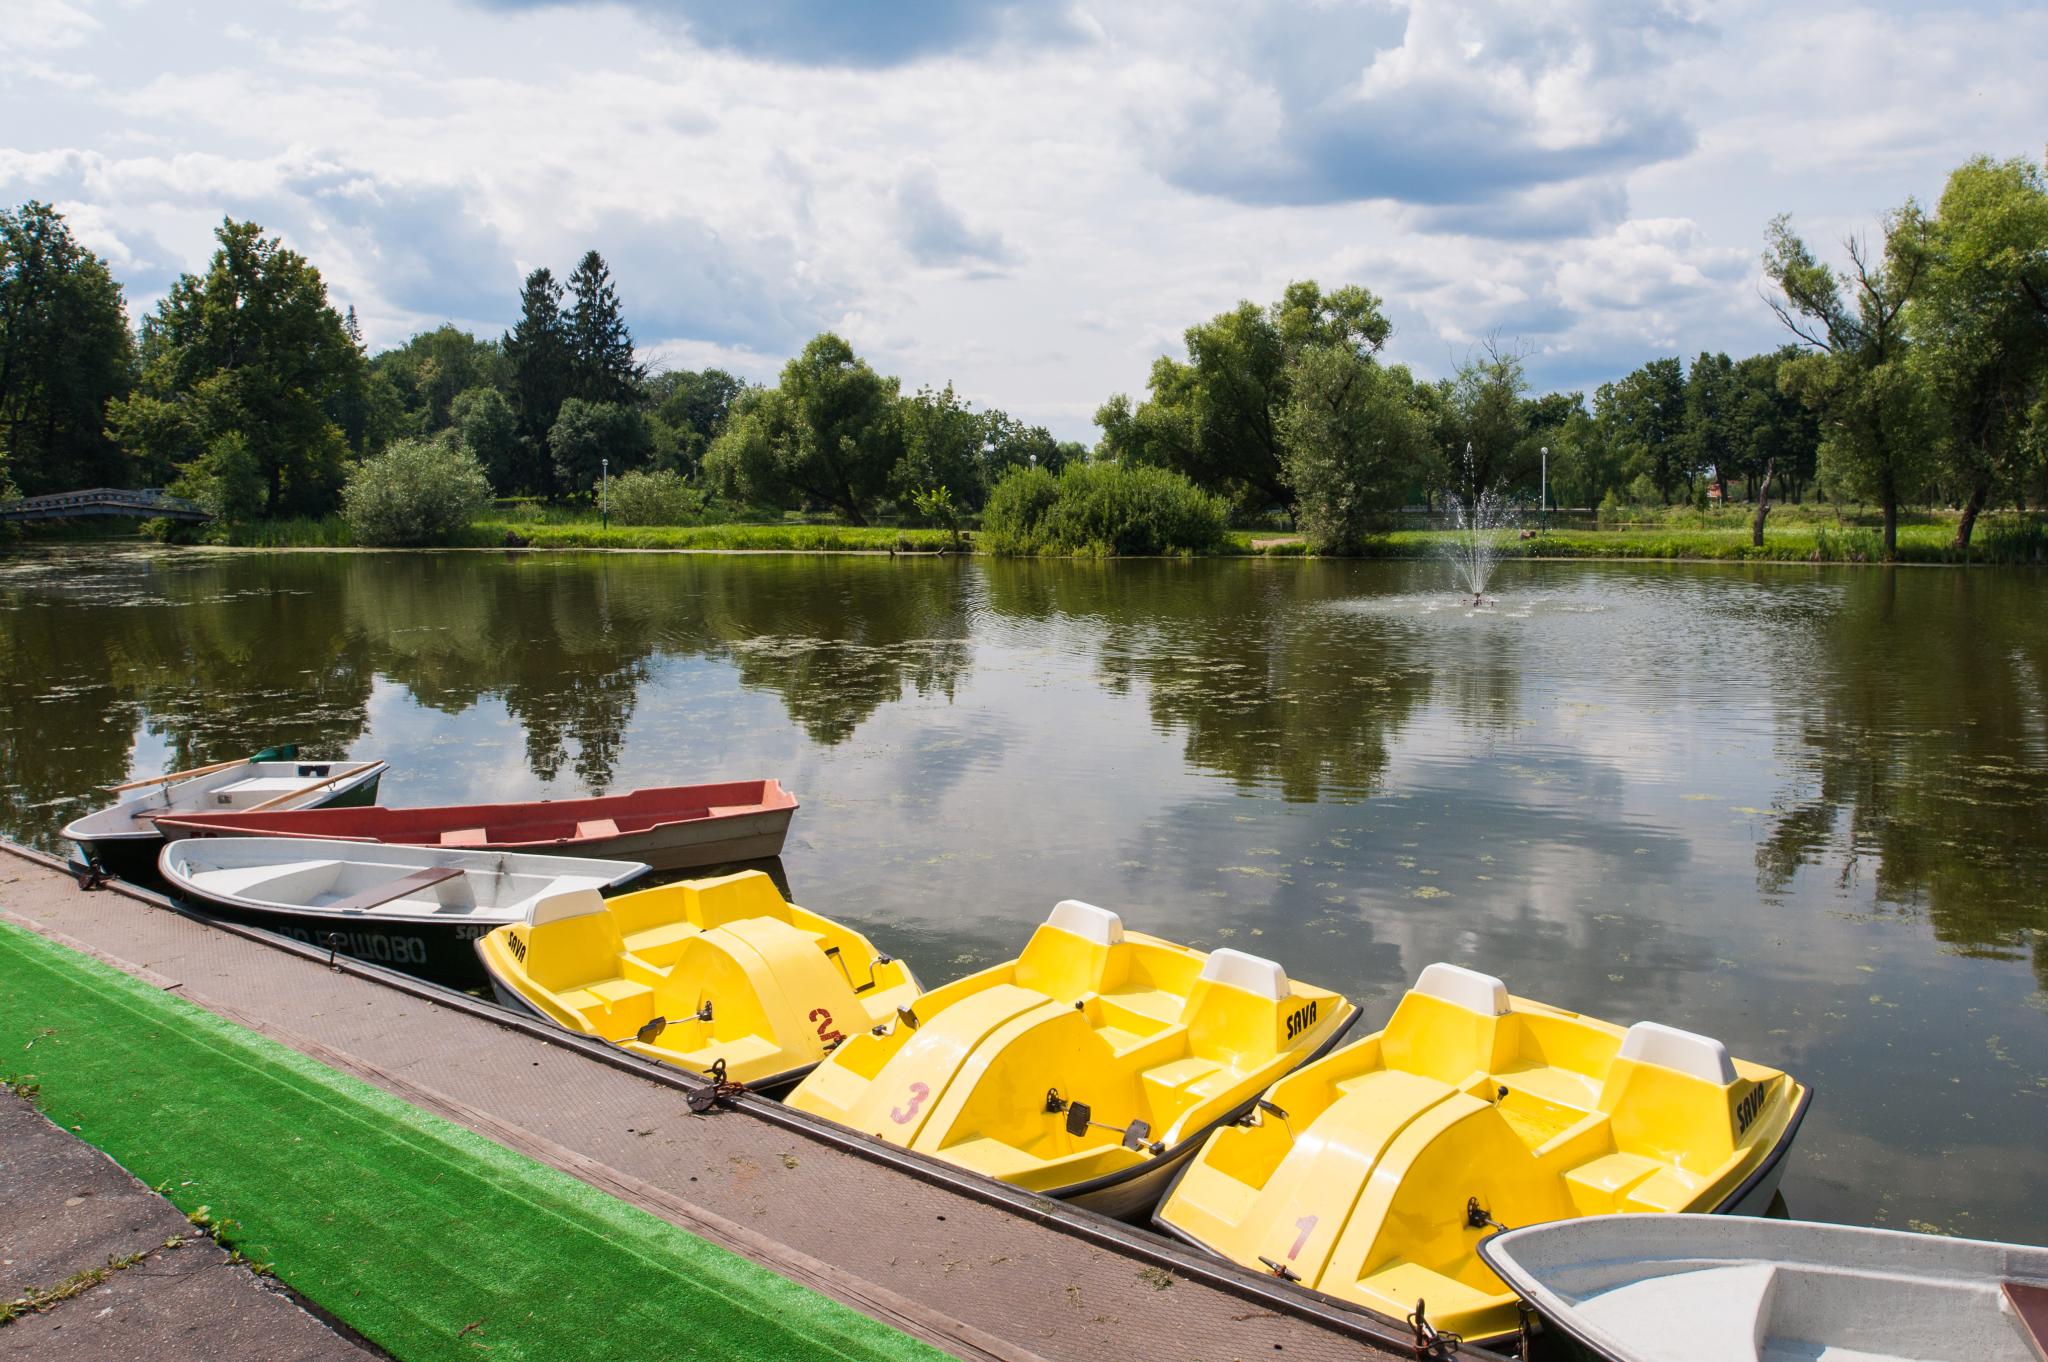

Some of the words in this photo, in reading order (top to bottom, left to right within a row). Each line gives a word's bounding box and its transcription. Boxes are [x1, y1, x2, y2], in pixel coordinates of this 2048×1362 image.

[455, 925, 492, 940] SAV
[508, 931, 526, 963] SAVA
[808, 1008, 842, 1042] 2
[1286, 1001, 1317, 1040] SAVA
[890, 1082, 930, 1124] 3
[1736, 1082, 1764, 1134] SAVA
[1287, 1214, 1319, 1261] 1
